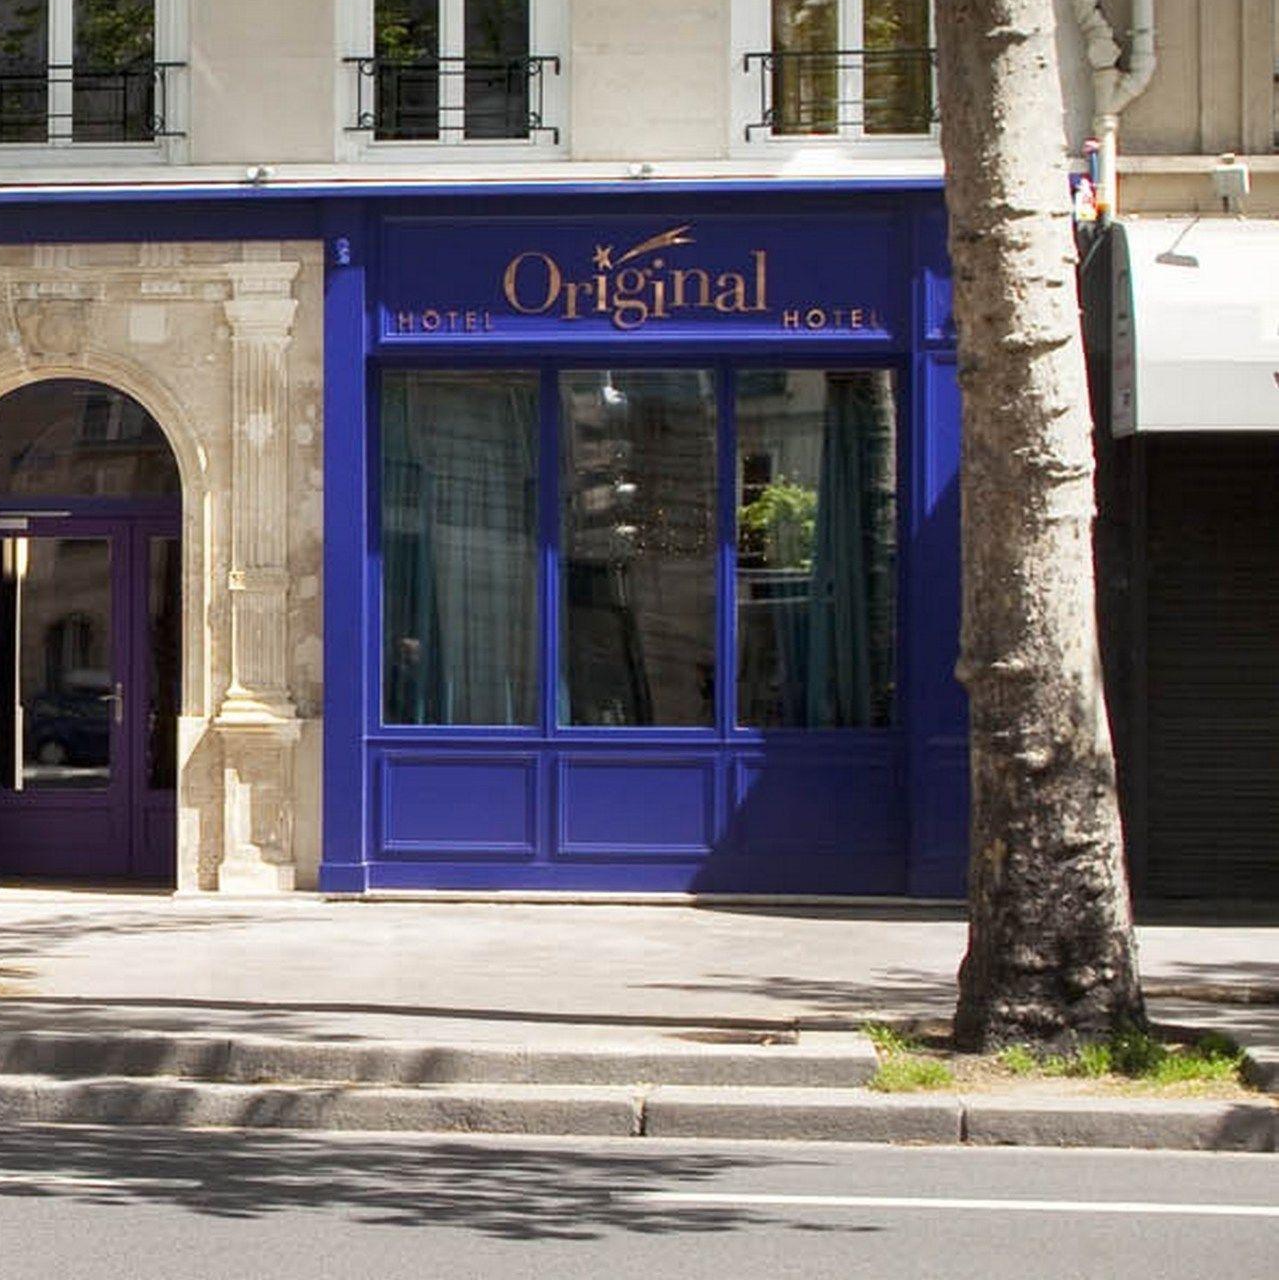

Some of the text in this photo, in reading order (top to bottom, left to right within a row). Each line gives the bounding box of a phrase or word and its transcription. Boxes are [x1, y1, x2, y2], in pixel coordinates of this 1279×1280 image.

[398, 246, 884, 330] HOTEL Original HOTEL
